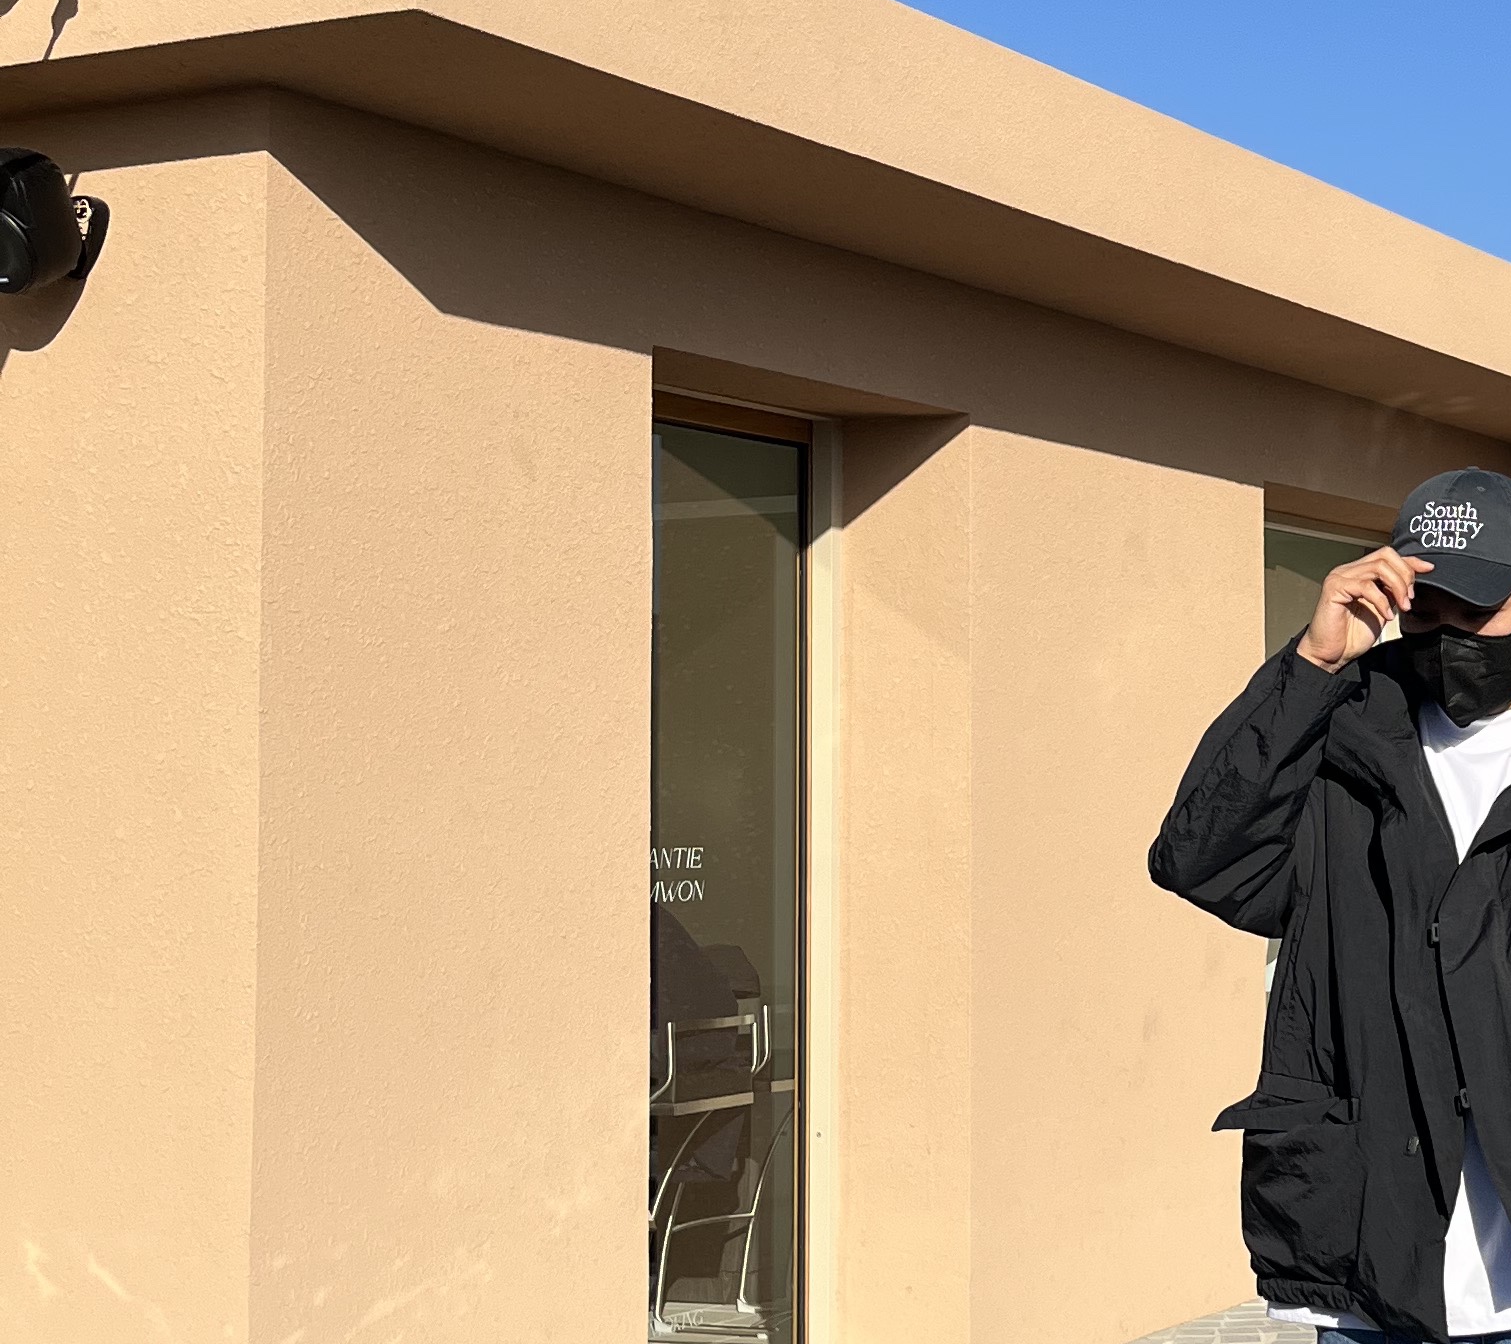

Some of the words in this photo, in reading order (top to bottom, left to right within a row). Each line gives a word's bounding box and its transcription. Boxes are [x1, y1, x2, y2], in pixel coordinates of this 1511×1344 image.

[1423, 501, 1478, 520] South
[1409, 515, 1484, 539] Country
[1421, 531, 1467, 550] Club
